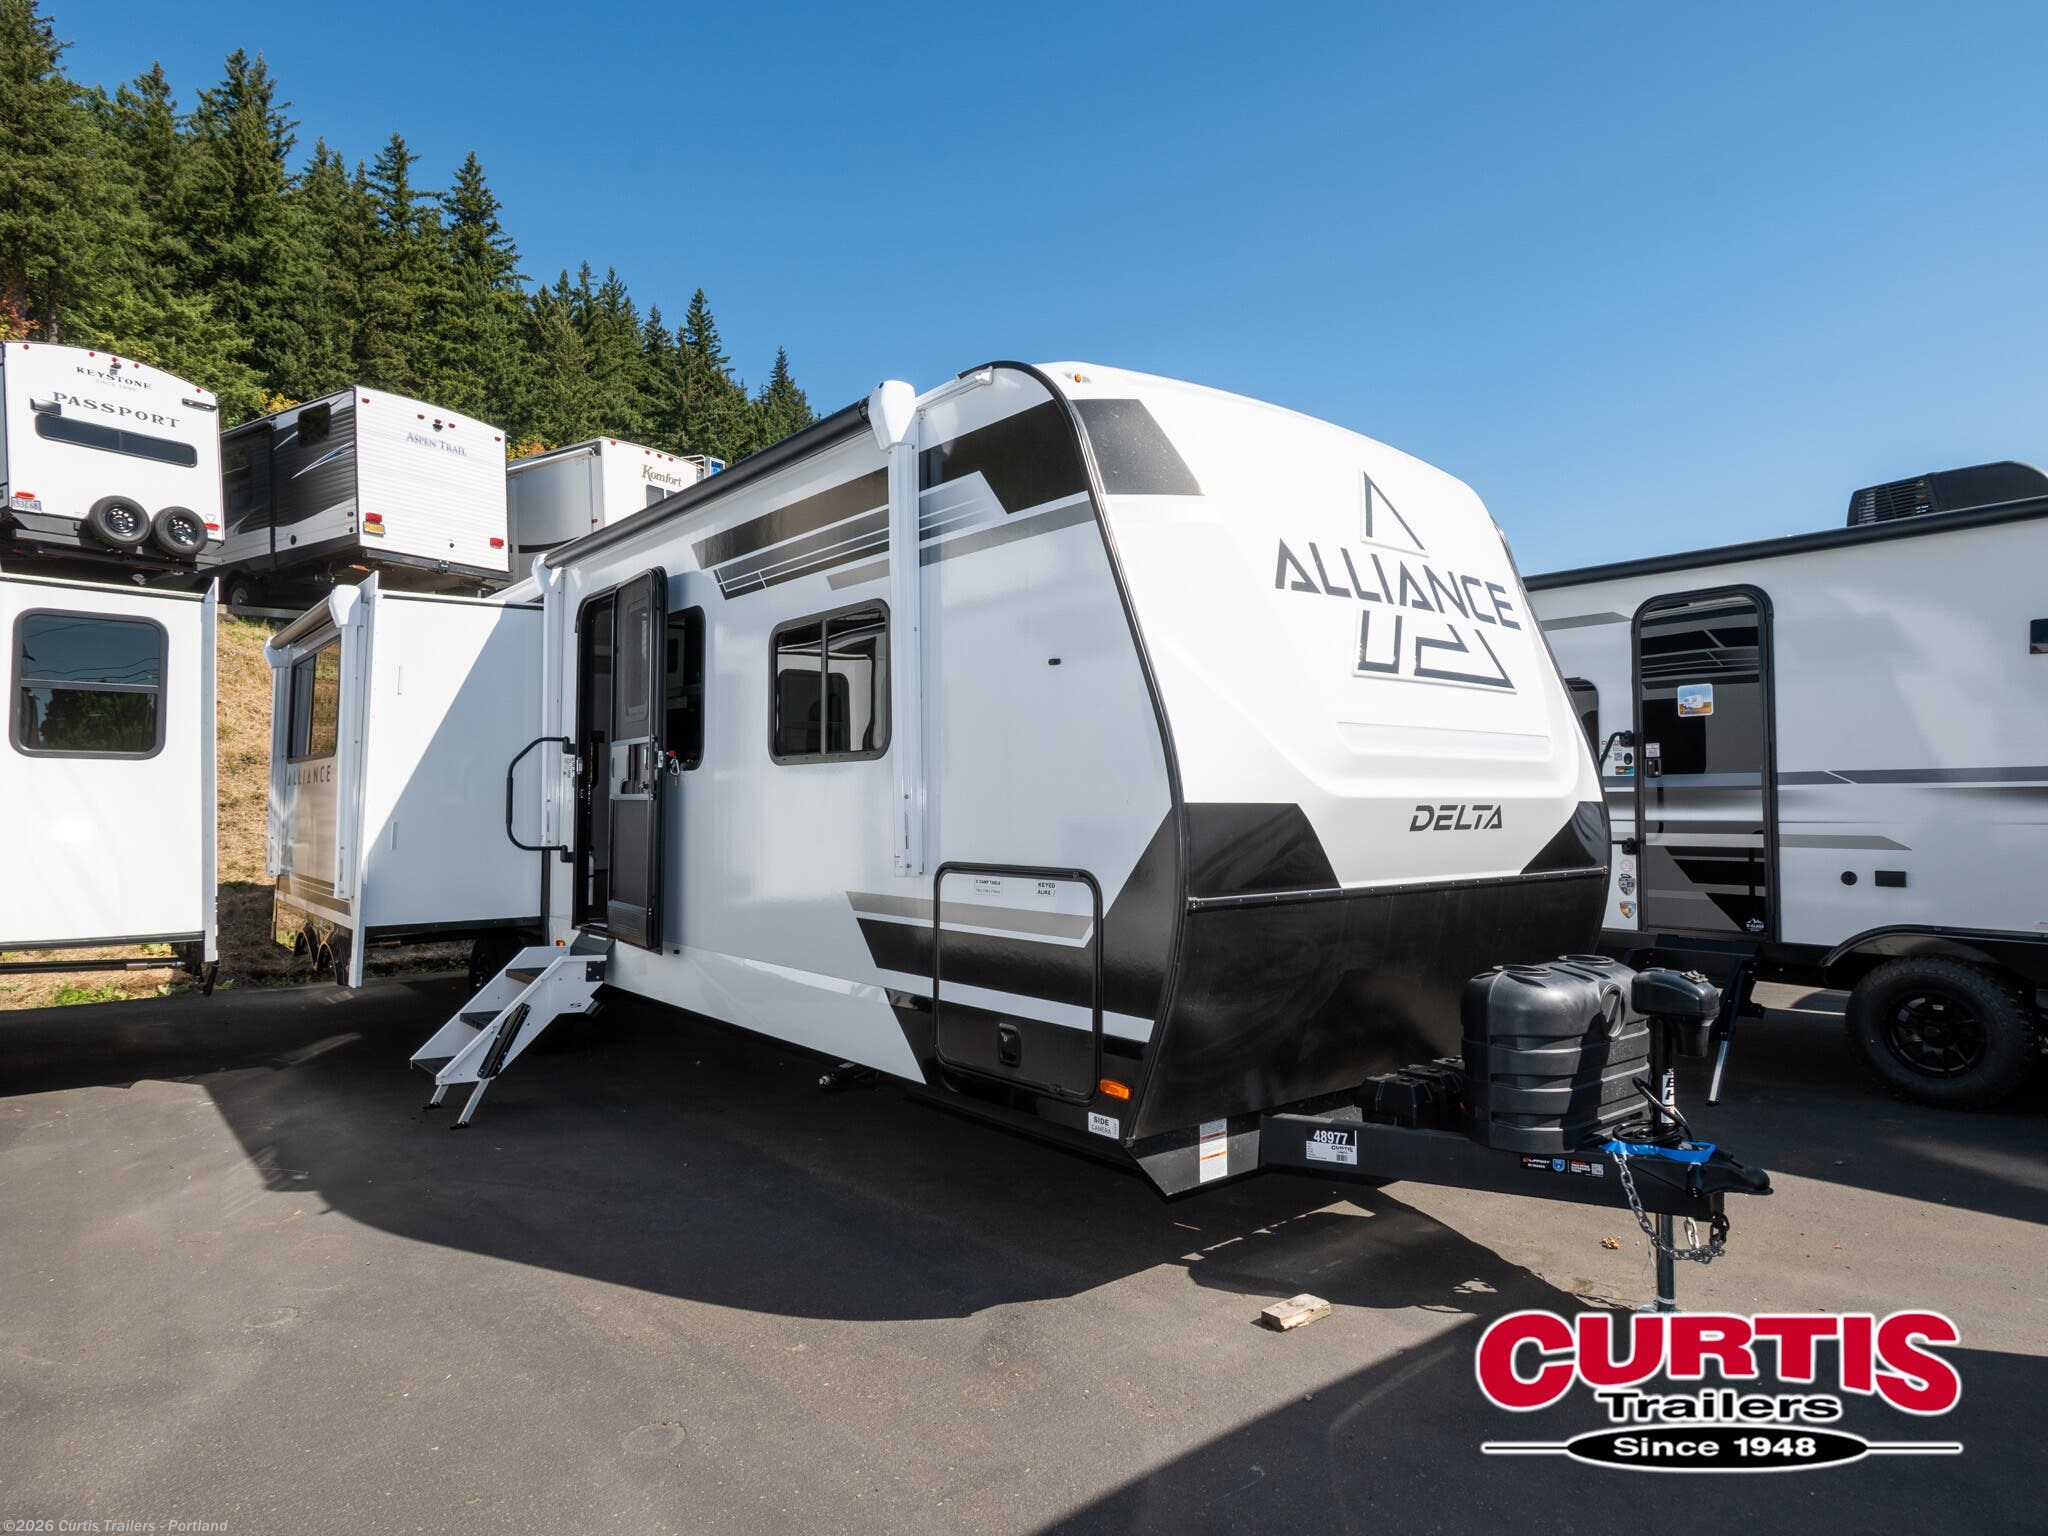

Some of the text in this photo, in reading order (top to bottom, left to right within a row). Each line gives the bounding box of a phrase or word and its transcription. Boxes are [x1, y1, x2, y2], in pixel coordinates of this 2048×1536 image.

[76, 366, 153, 391] KEYSTONE
[53, 391, 181, 429] PASSPORT
[406, 432, 468, 457] ASPEN TRAIL
[641, 463, 682, 488] Komfort
[1274, 537, 1522, 631] ALLIANCE
[287, 764, 331, 787] ALLIANCE
[1409, 803, 1503, 833] DELTA
[1093, 1115, 1110, 1127] SIDE
[1312, 1129, 1348, 1145] 48977
